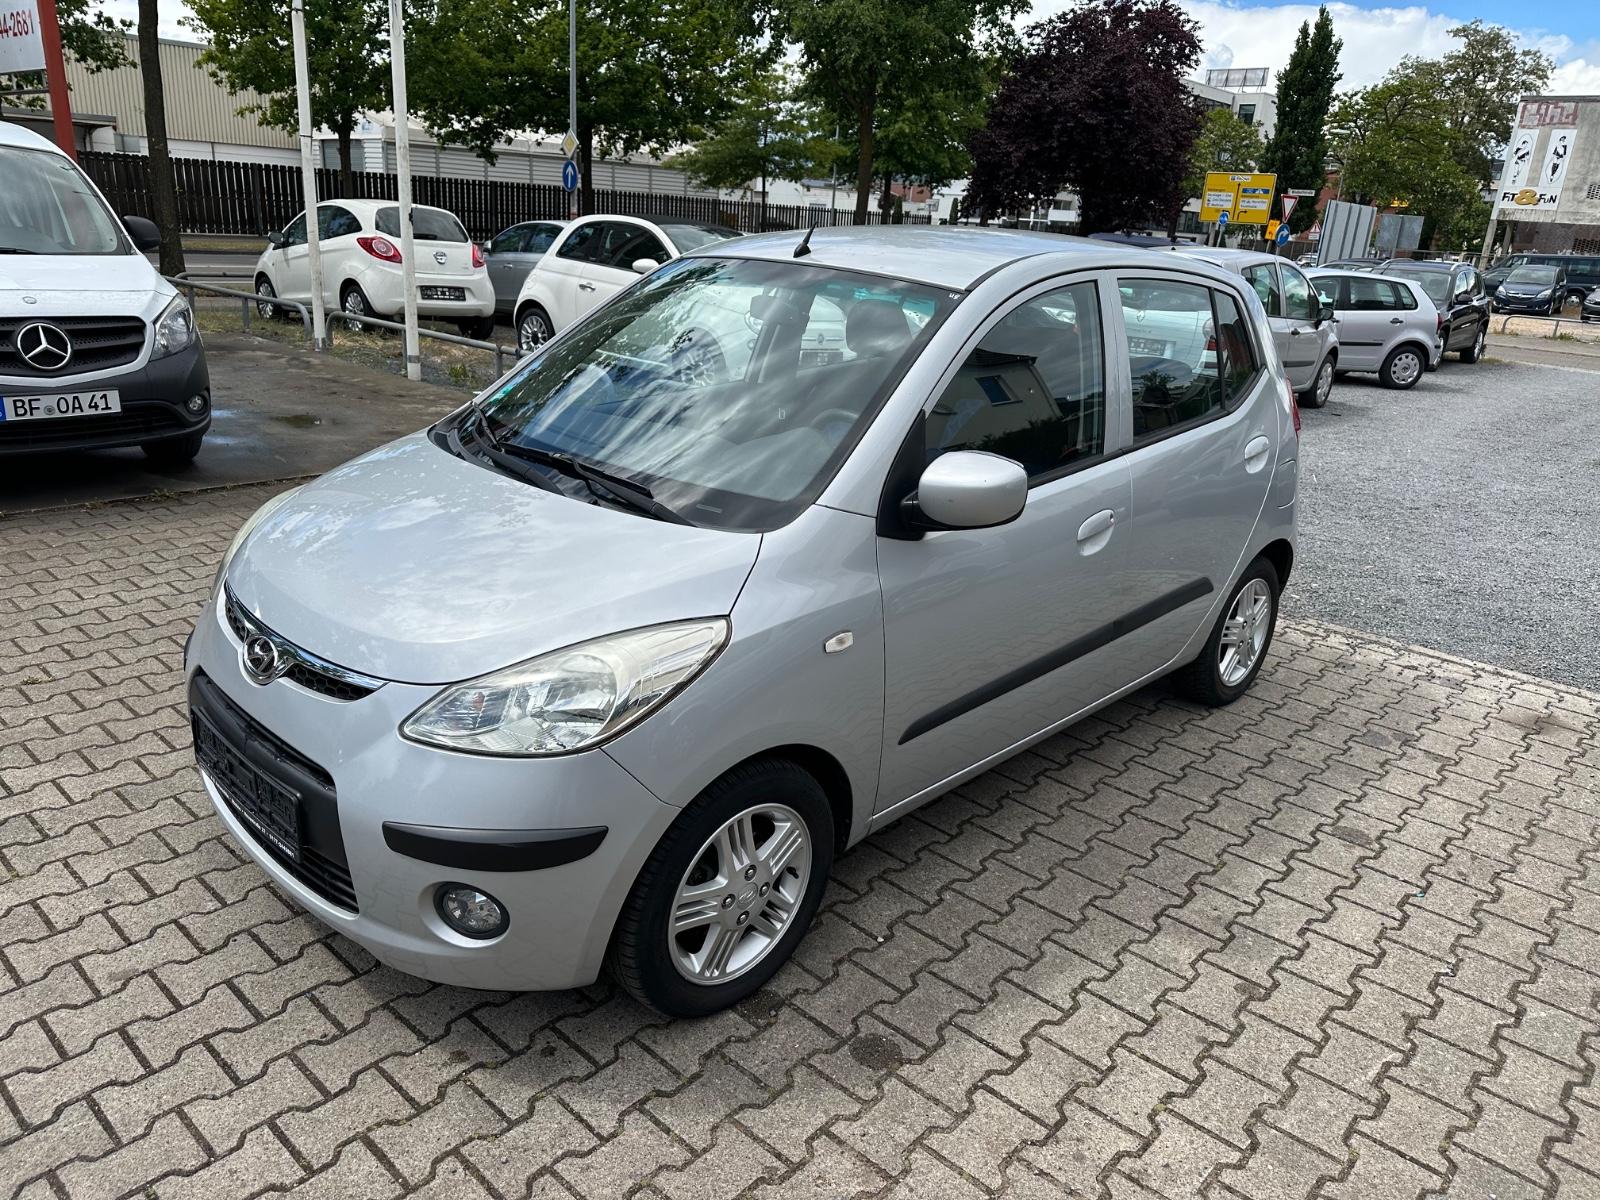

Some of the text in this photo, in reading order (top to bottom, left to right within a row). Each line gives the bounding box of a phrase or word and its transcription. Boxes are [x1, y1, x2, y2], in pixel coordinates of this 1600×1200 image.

[1514, 188, 1539, 206] &
[12, 393, 112, 417] BF OA 41
